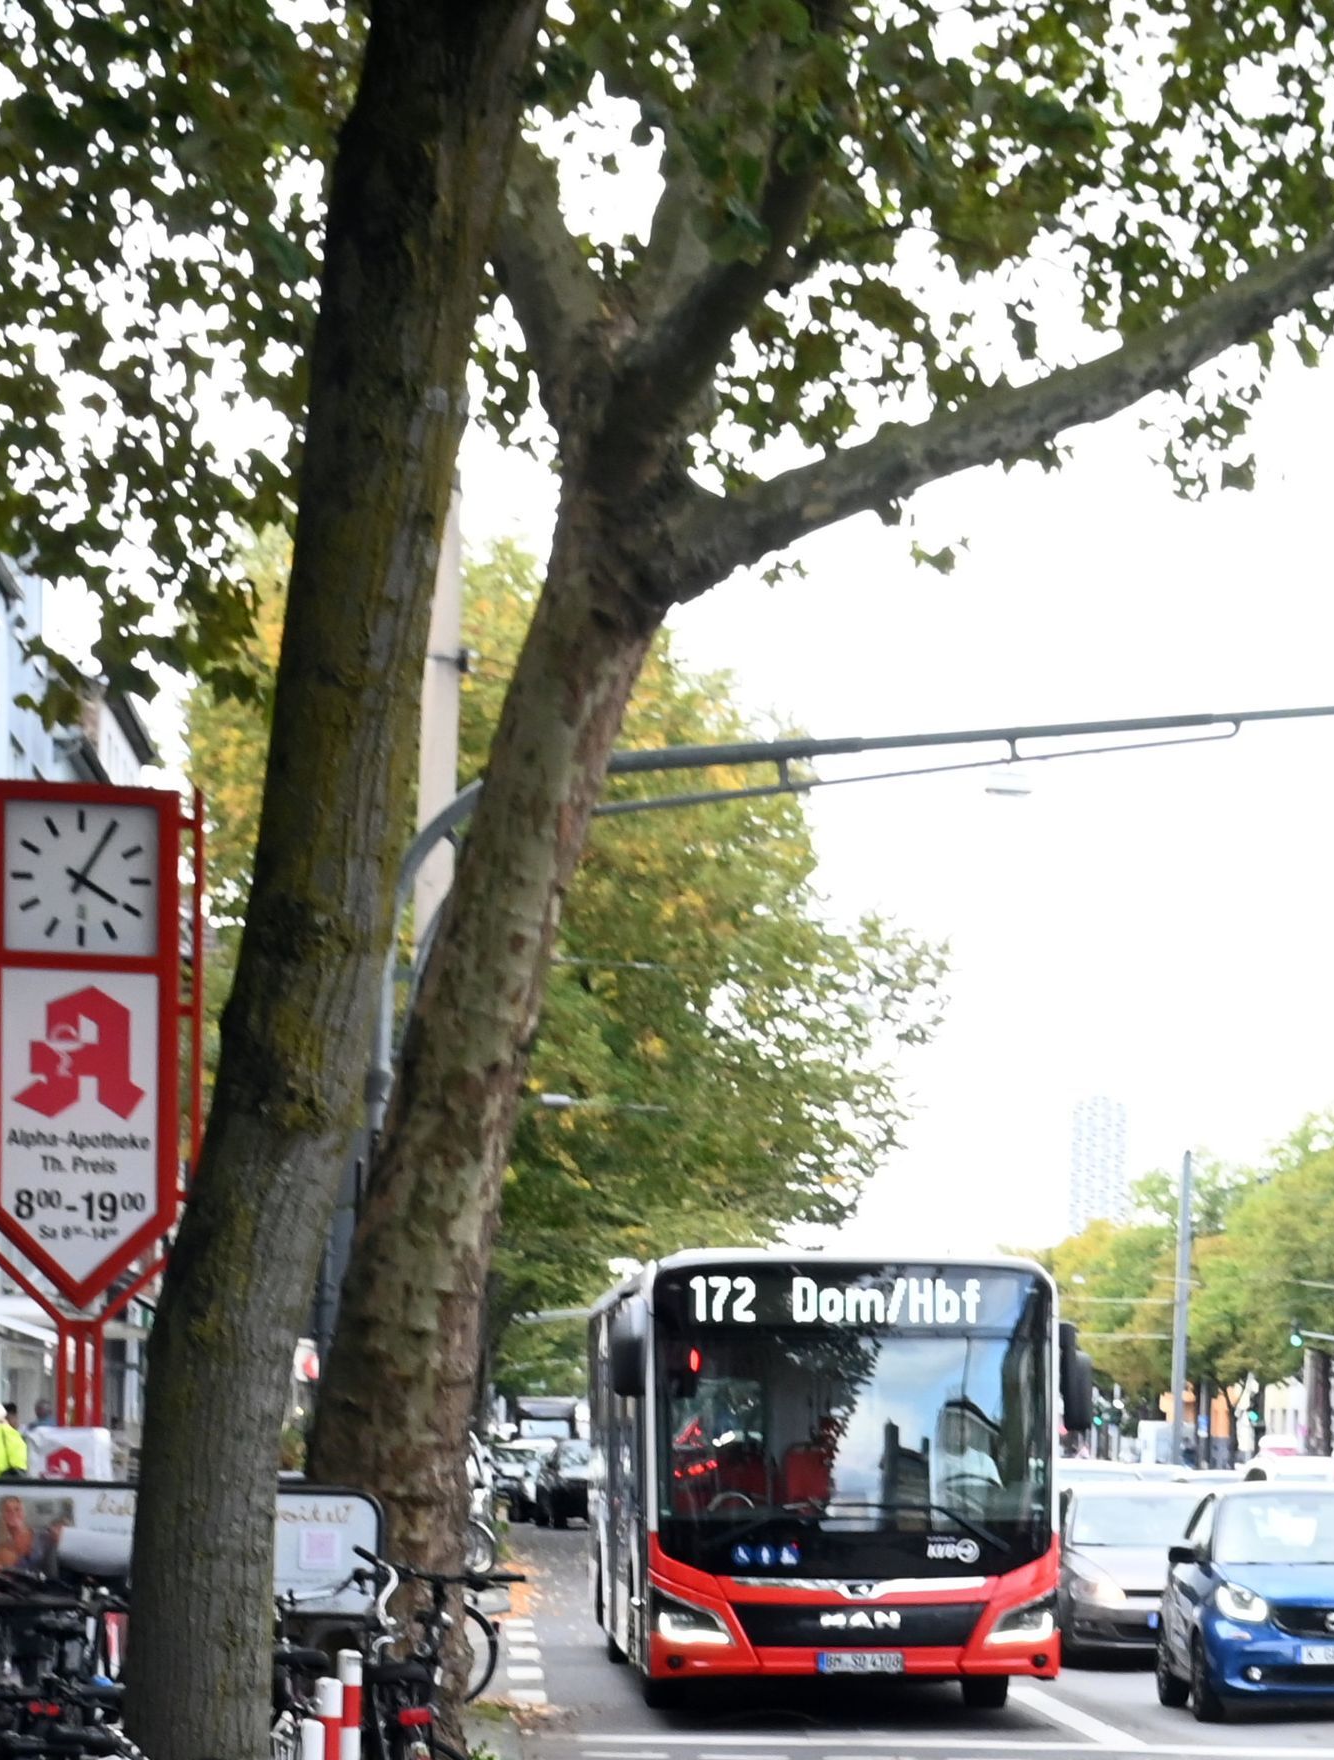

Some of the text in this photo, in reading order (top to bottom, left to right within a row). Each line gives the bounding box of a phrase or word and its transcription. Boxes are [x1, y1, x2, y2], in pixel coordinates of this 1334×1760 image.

[7, 1127, 152, 1151] Alpha-Apotheke
[71, 1156, 117, 1175] Preis
[689, 1275, 981, 1324] 172 Dom/Hbf
[819, 1610, 902, 1630] MAN
